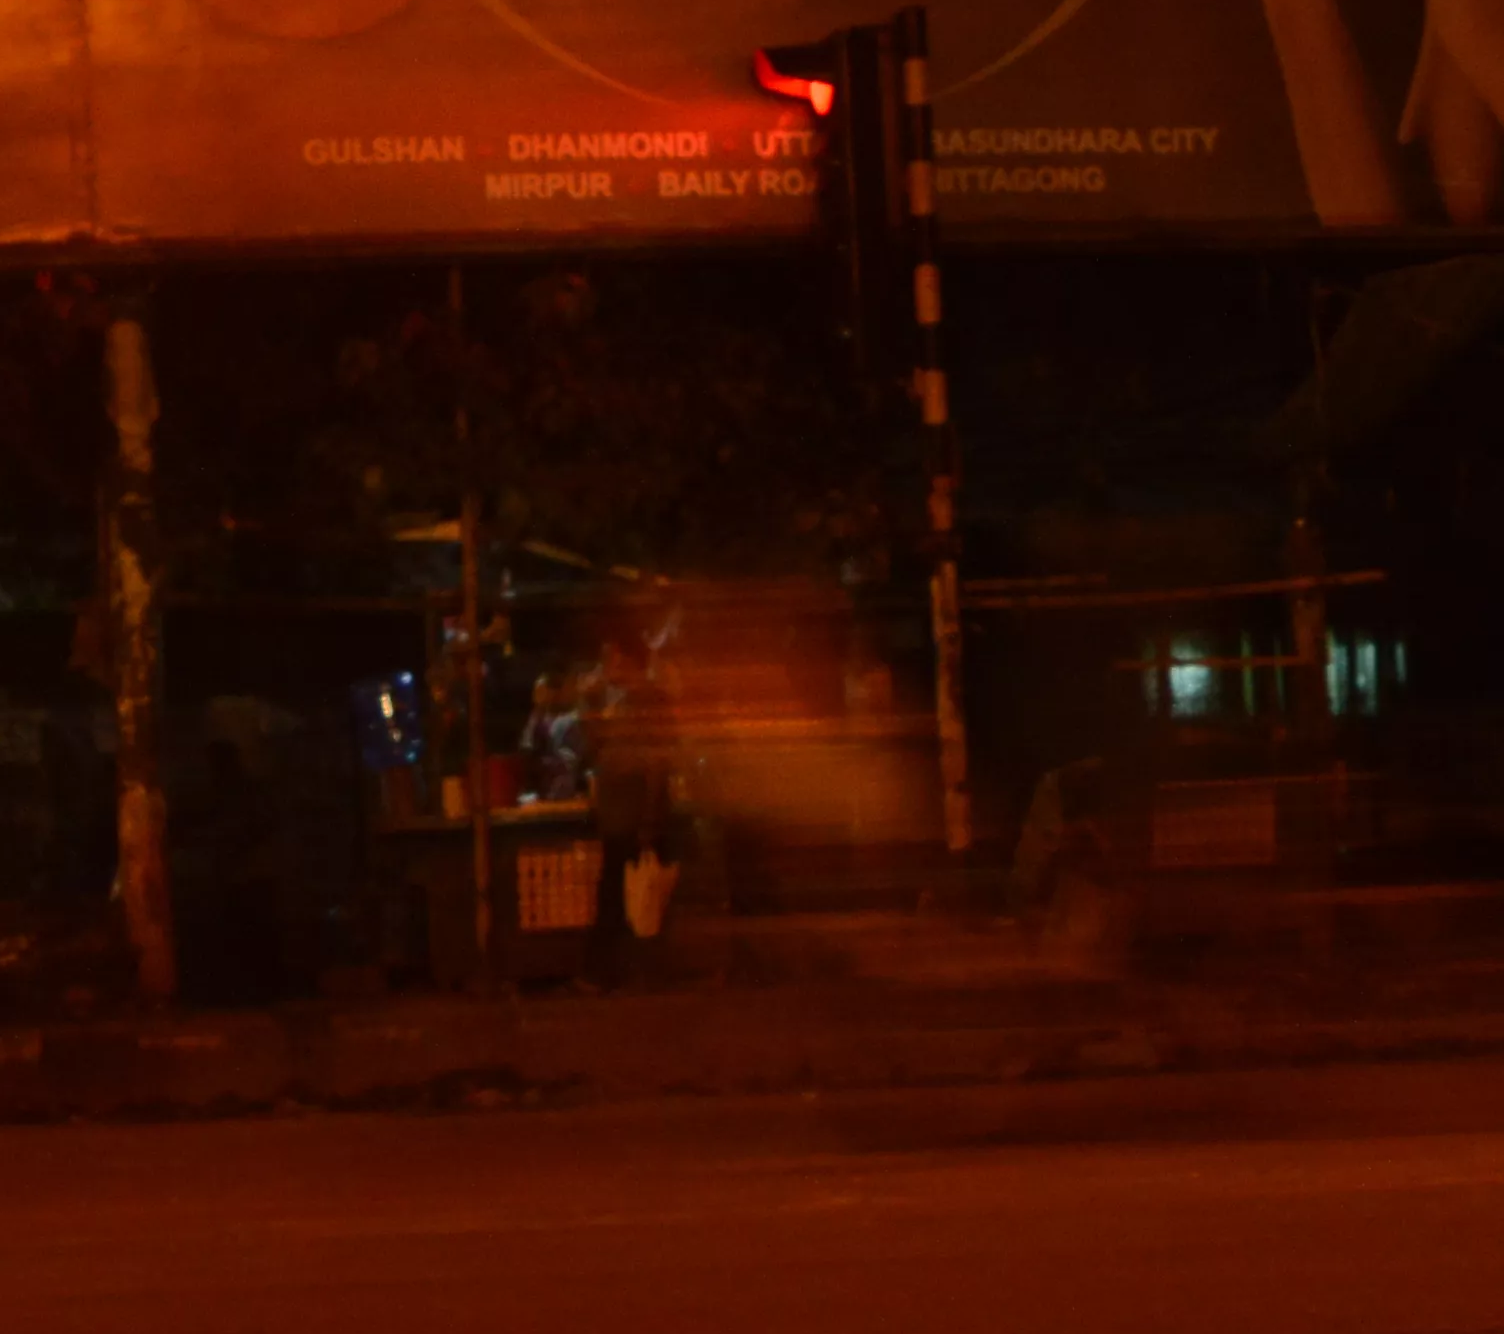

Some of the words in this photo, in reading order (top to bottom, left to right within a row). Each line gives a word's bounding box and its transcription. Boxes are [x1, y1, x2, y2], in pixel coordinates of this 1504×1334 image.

[302, 135, 465, 166] GULSHAN
[508, 130, 709, 161] DHANMONDI
[752, 129, 816, 159] UTT
[1147, 126, 1221, 155] CITY
[485, 172, 613, 201] MIRPUR
[657, 170, 751, 198] BAILY
[757, 168, 817, 197] RO
